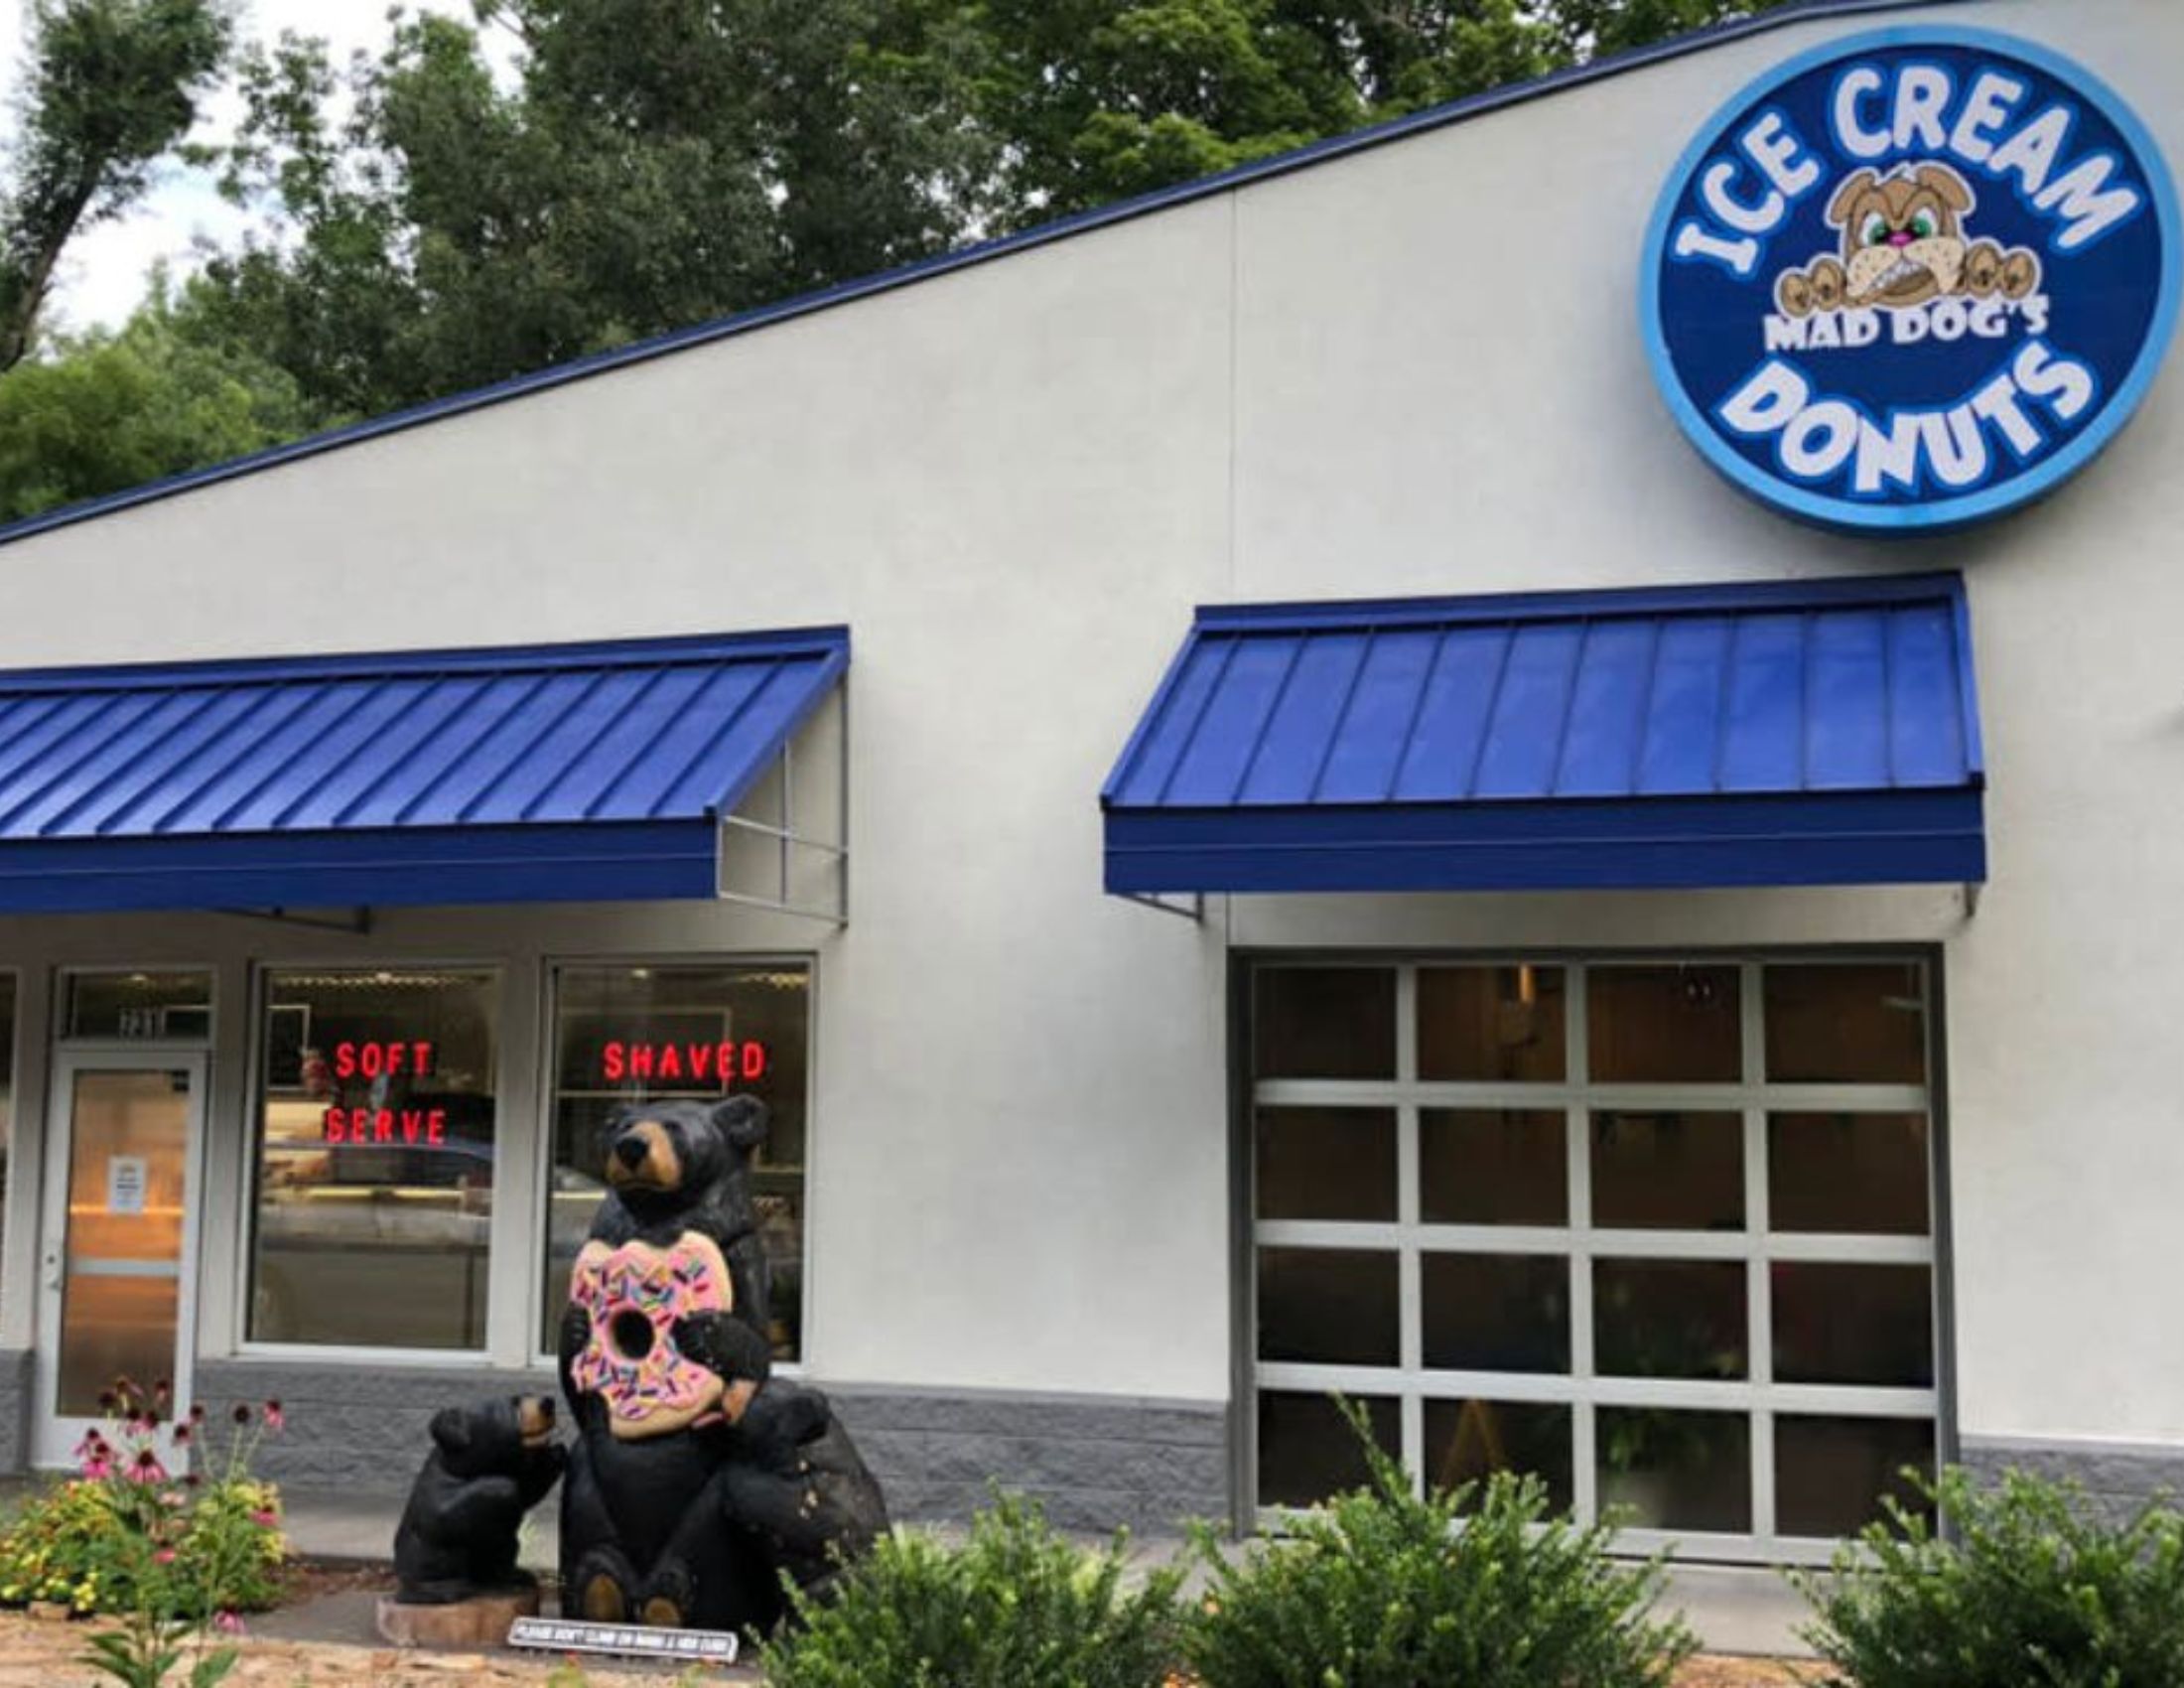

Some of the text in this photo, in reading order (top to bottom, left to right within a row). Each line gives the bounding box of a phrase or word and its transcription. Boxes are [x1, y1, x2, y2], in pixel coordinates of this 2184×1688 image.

[1674, 66, 2138, 274] ICE CREAM
[1763, 295, 2050, 351] MAD DOG'S
[1720, 341, 2094, 492] DONUTS
[336, 1042, 434, 1079] SOFT
[604, 1041, 766, 1080] SHAVED
[325, 1107, 446, 1144] SERVE
